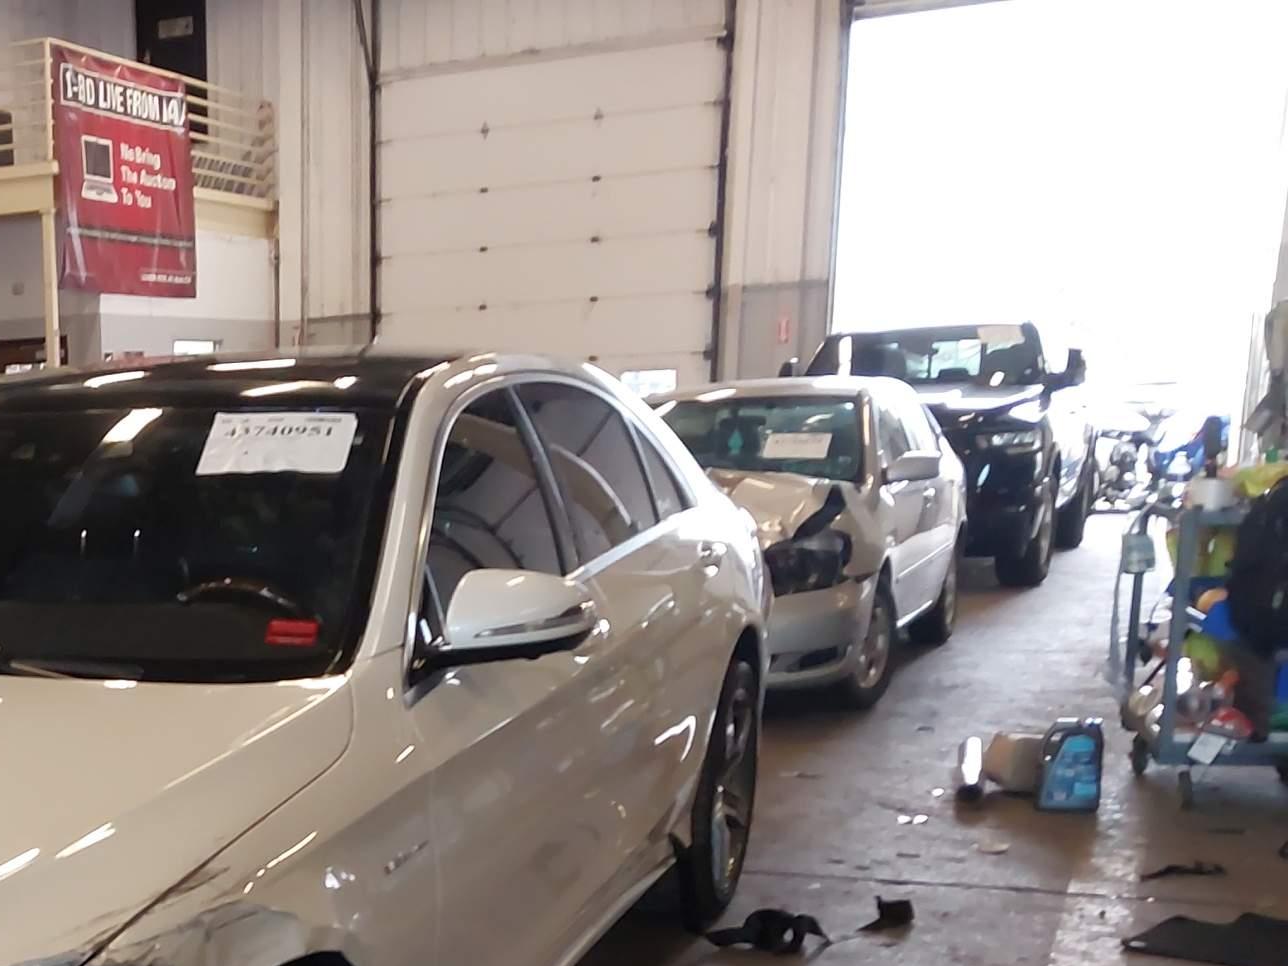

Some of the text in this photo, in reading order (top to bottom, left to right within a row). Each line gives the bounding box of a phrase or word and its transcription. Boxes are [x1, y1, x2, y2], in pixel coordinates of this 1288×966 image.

[98, 80, 125, 113] LIVE
[126, 87, 160, 121] FROM
[135, 145, 161, 170] Bring
[120, 165, 138, 184] The
[121, 187, 152, 208] To You
